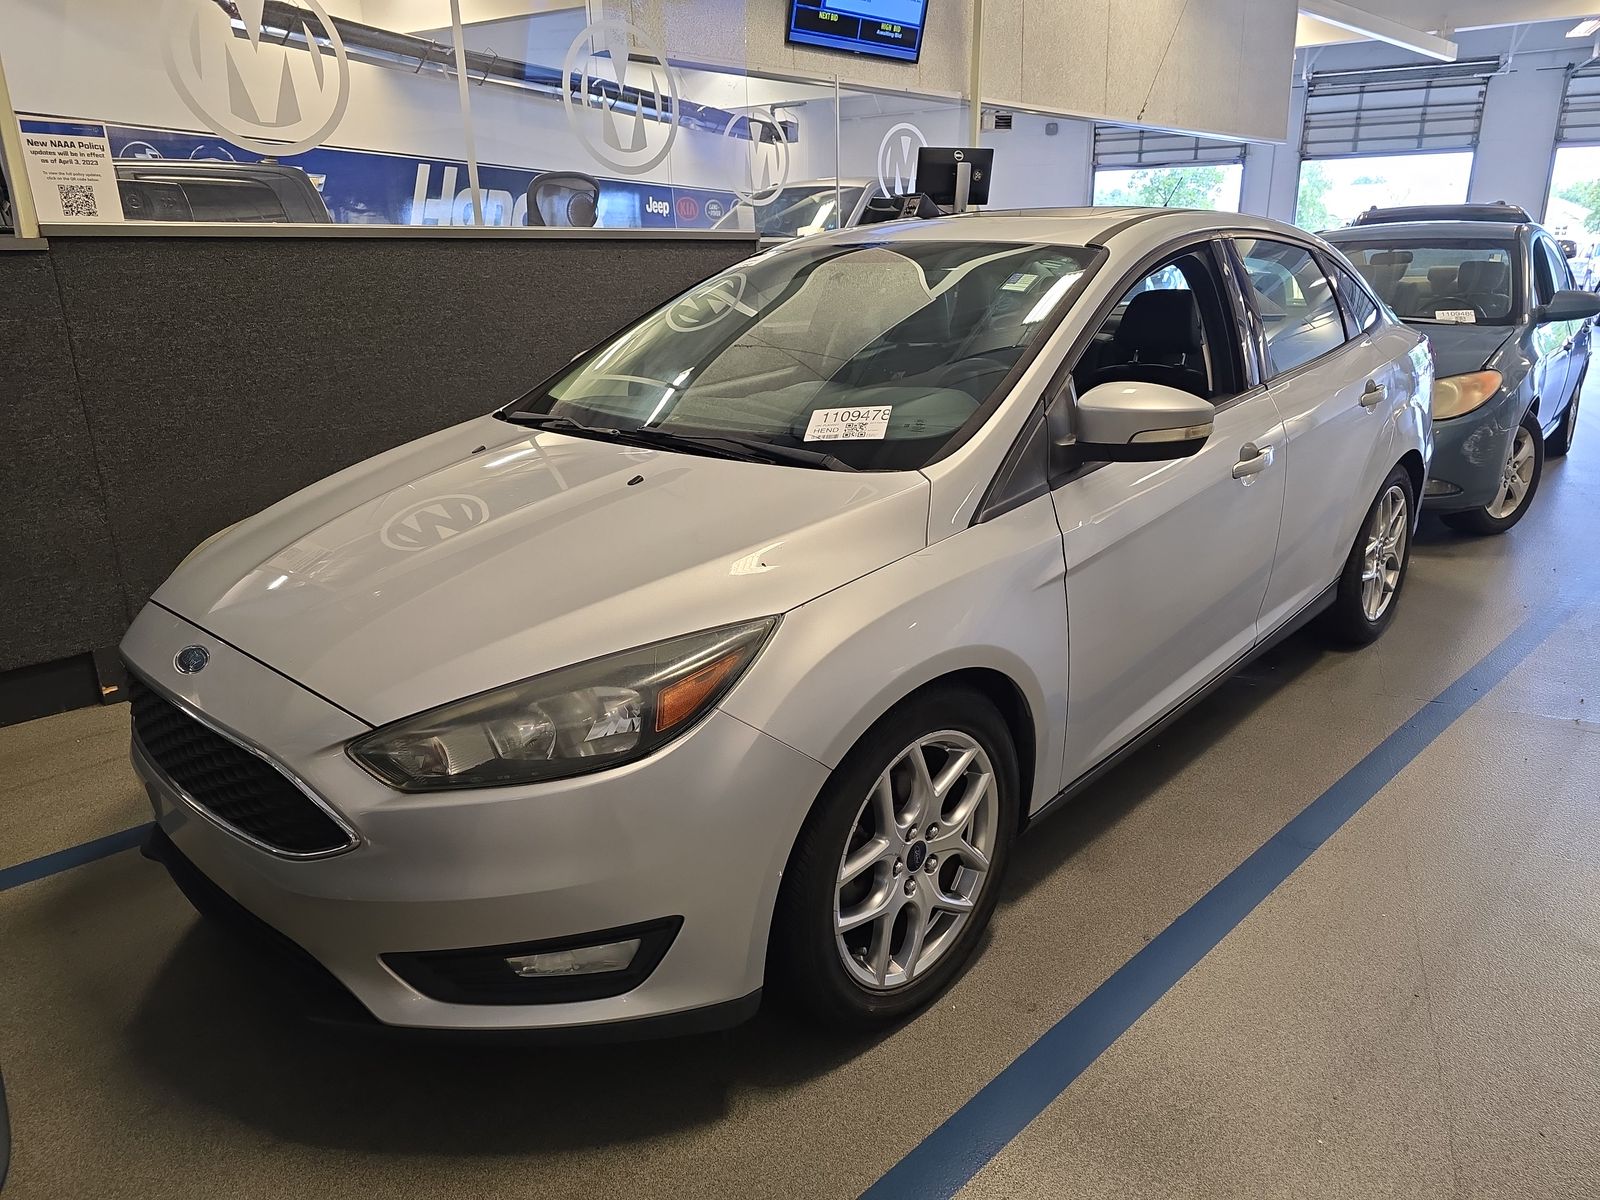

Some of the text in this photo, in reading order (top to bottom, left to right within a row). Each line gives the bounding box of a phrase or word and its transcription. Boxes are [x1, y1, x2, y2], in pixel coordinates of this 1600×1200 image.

[818, 11, 839, 22] NEXT BID
[881, 23, 902, 33] HIGH BID
[26, 138, 105, 152] New NAAA Policy
[30, 149, 56, 157] updates
[87, 151, 105, 159] effect
[58, 158, 73, 166] April
[645, 196, 669, 217] Jeep
[679, 201, 696, 216] KIA
[823, 409, 890, 423] 1109478
[813, 426, 840, 435] HEND
